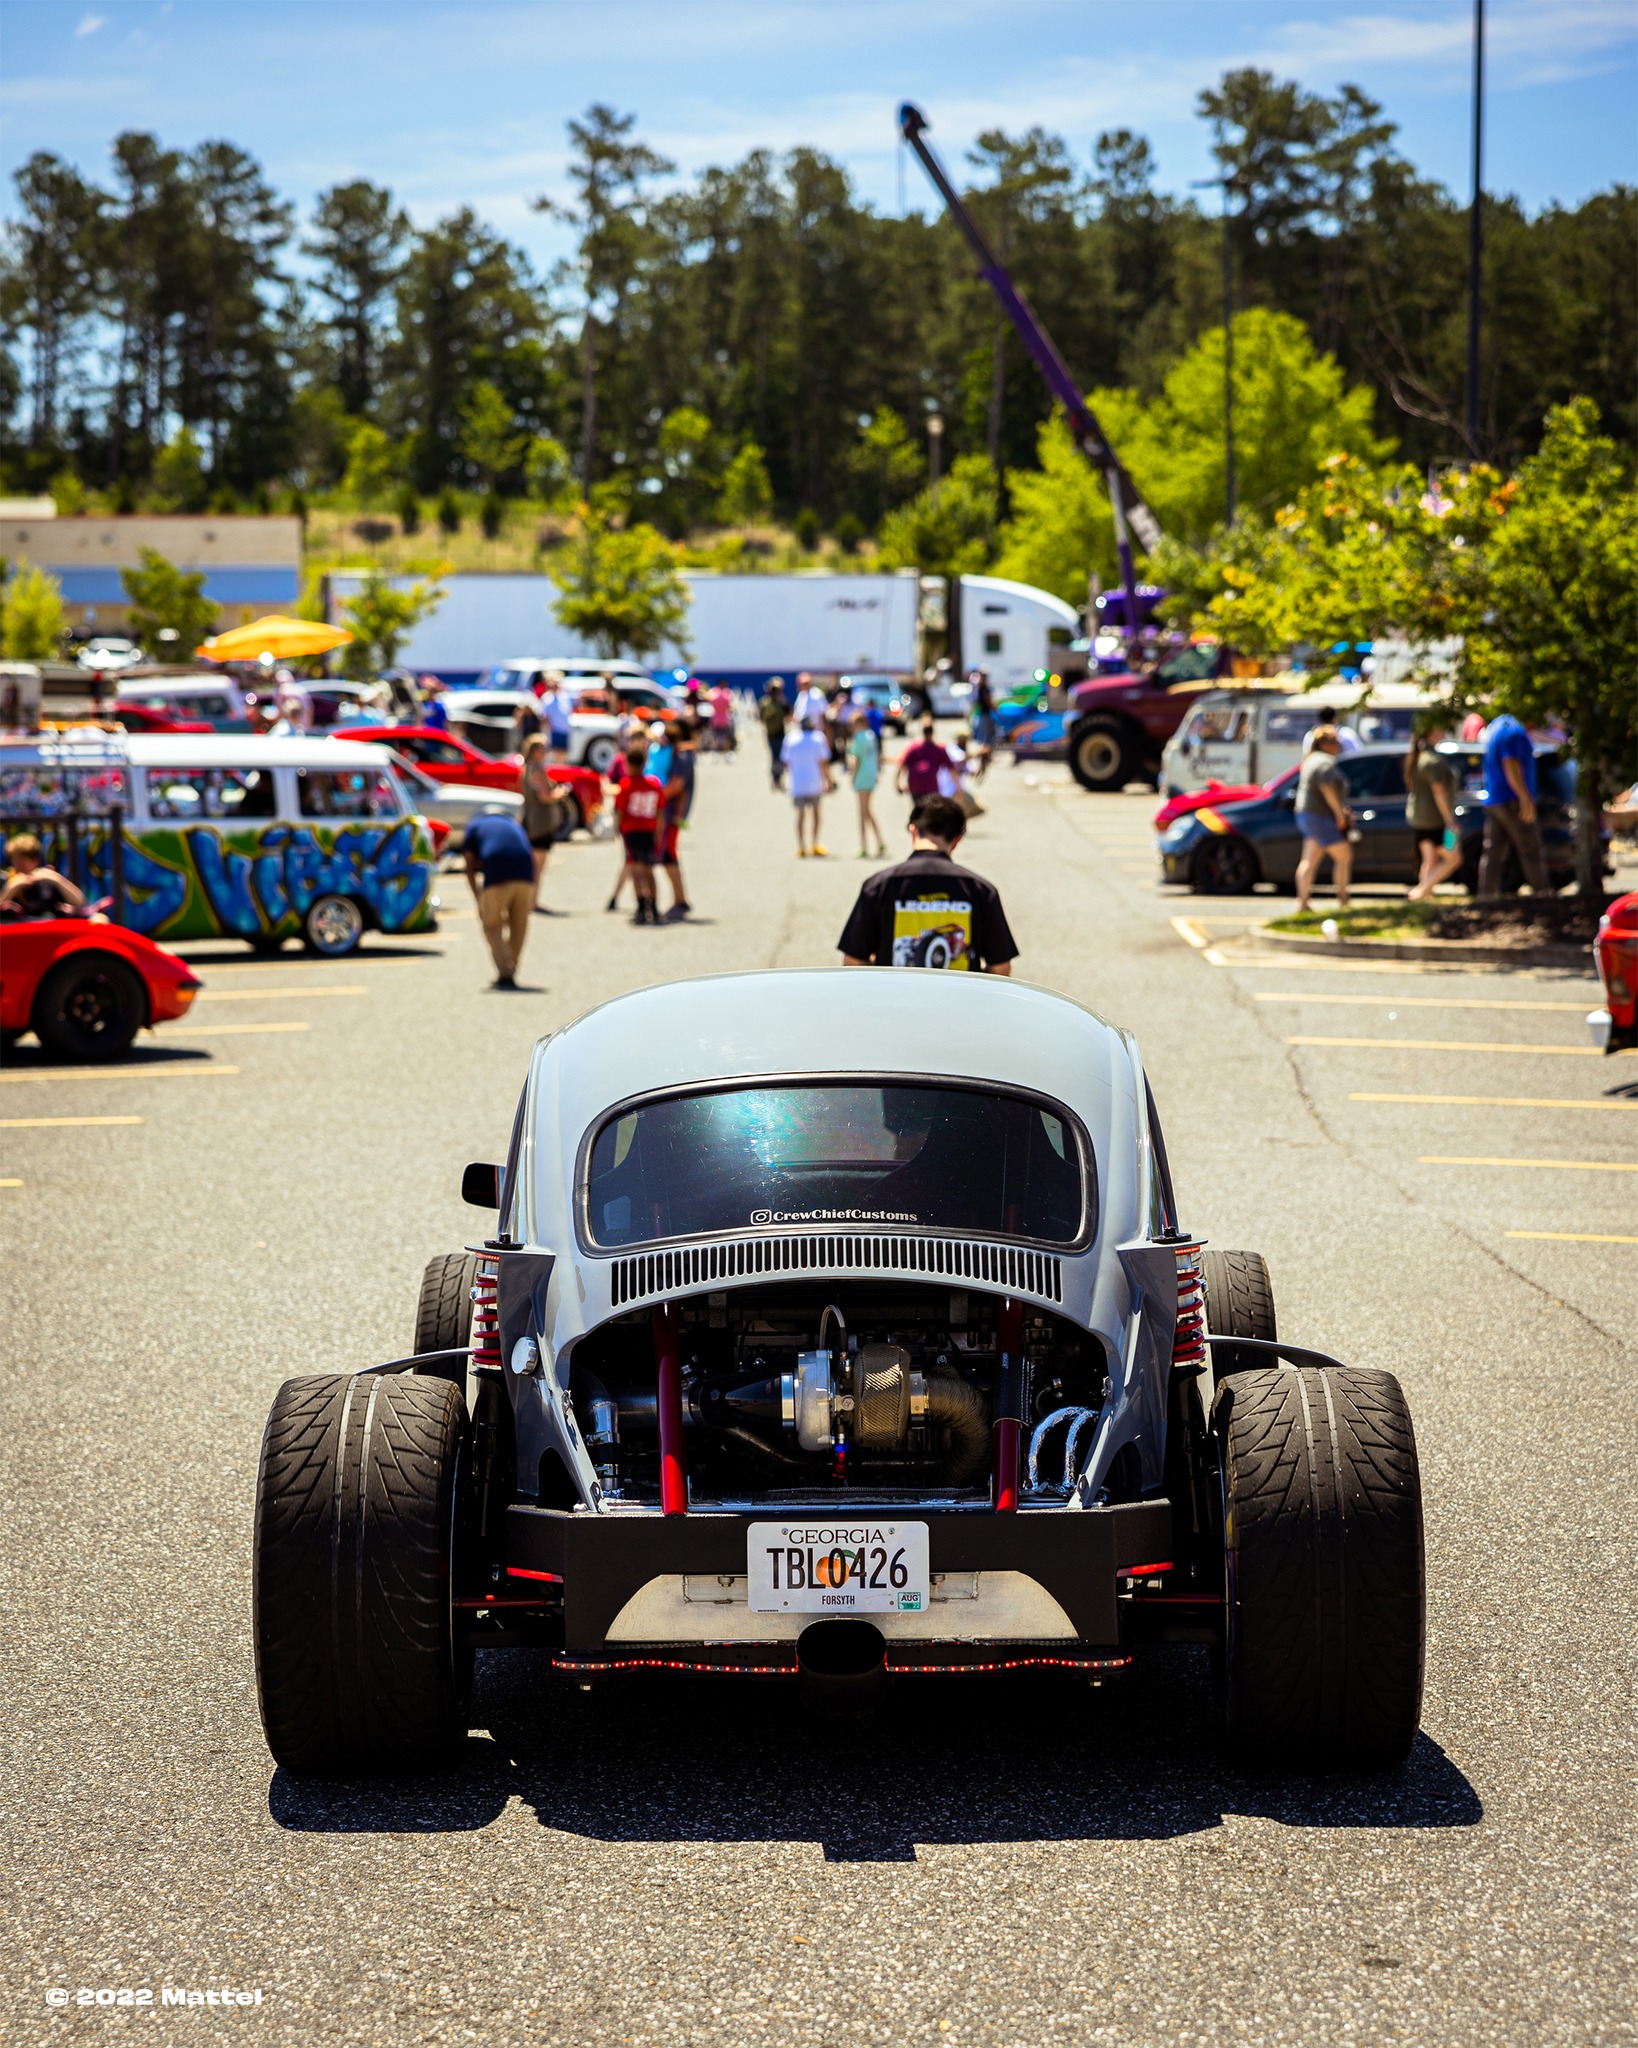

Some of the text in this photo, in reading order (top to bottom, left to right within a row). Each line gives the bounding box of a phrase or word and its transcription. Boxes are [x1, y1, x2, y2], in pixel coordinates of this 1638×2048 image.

[895, 900, 972, 913] LEGEND
[773, 1209, 918, 1222] CrewChiefCustoms
[789, 1529, 885, 1544] GEORGIA
[766, 1547, 908, 1590] TBL0426
[821, 1595, 855, 1605] FORSYTH
[900, 1594, 919, 1602] AUG
